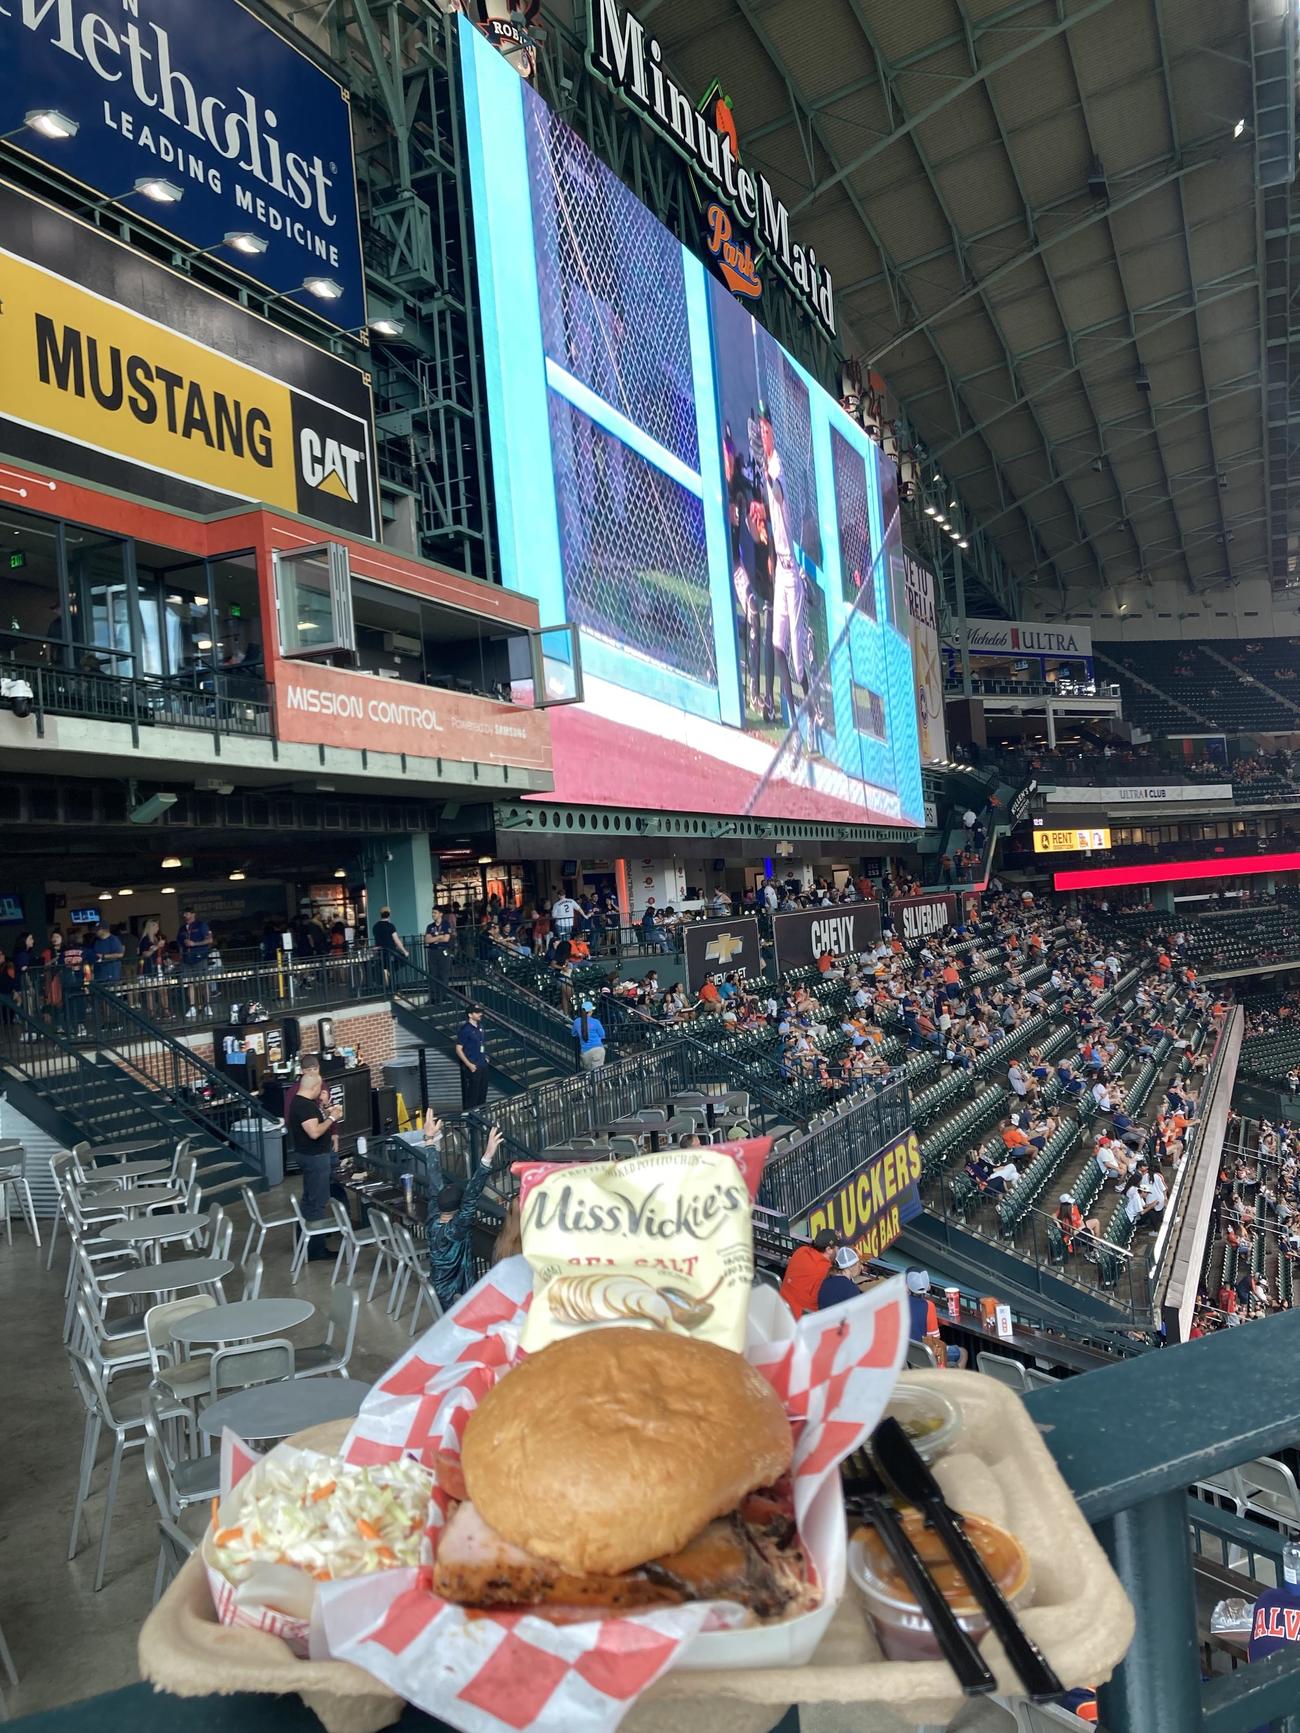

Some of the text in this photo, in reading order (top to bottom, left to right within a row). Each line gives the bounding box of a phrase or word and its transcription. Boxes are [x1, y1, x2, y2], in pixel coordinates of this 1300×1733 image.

[103, 100, 339, 268] LEADING MEDICINE
[599, 0, 835, 337] Minute Maid
[707, 204, 760, 288] Park
[34, 312, 274, 469] MUSTANG
[300, 427, 361, 504] CAT
[905, 583, 936, 631] RELLA
[1022, 631, 1080, 652] ULTRA
[286, 685, 364, 720] MISSION
[368, 699, 445, 732] CONTROL
[1149, 789, 1167, 798] CLUB
[1052, 832, 1073, 844] RENT
[811, 915, 855, 960] CHEVY
[902, 902, 949, 939] SILVERADO
[522, 1183, 741, 1241] Miss Vickie's
[854, 1206, 900, 1258] ING BAR
[1254, 1606, 1300, 1640] ALV
